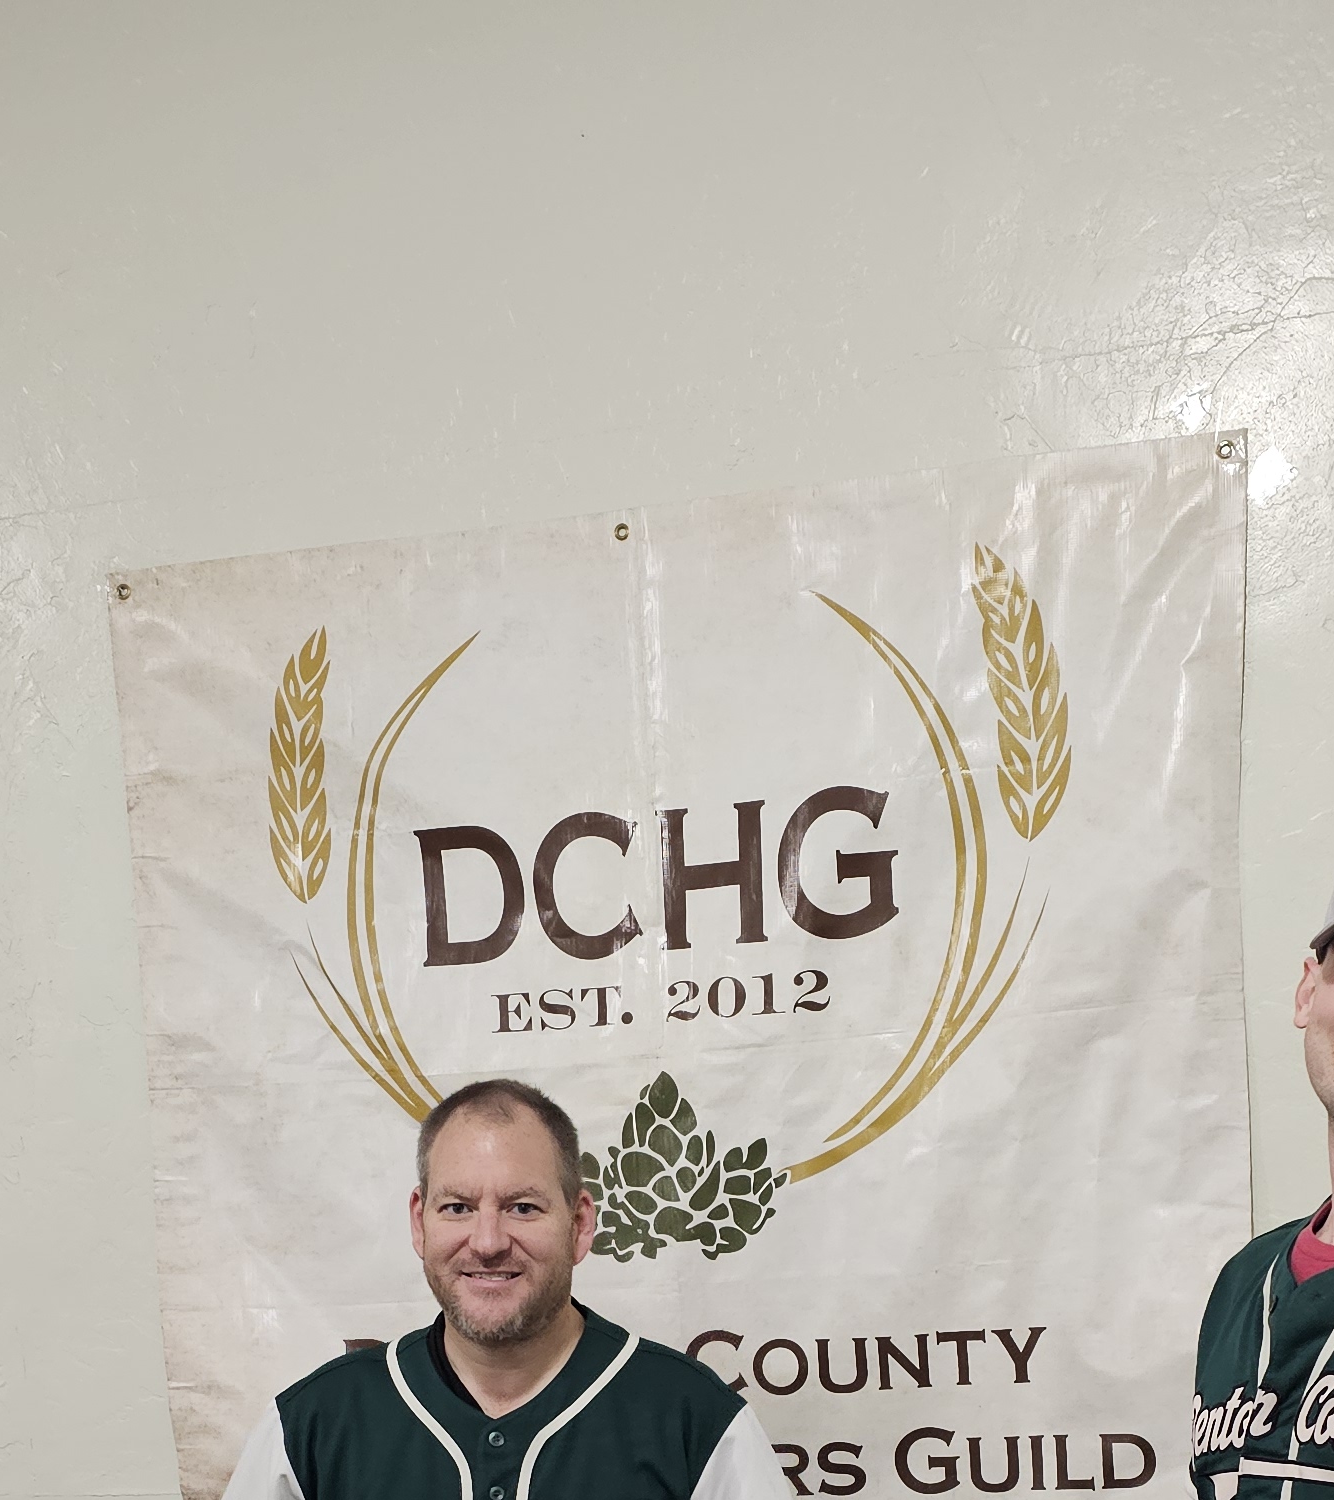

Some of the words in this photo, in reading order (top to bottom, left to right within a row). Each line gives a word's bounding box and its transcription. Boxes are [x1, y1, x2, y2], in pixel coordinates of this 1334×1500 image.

[413, 785, 899, 967] DCHG
[490, 985, 634, 1034] EST.
[666, 969, 832, 1023] 2012
[686, 1326, 1048, 1396] COUNTY
[1192, 1385, 1278, 1458] enton
[893, 1426, 1158, 1495] GUILD
